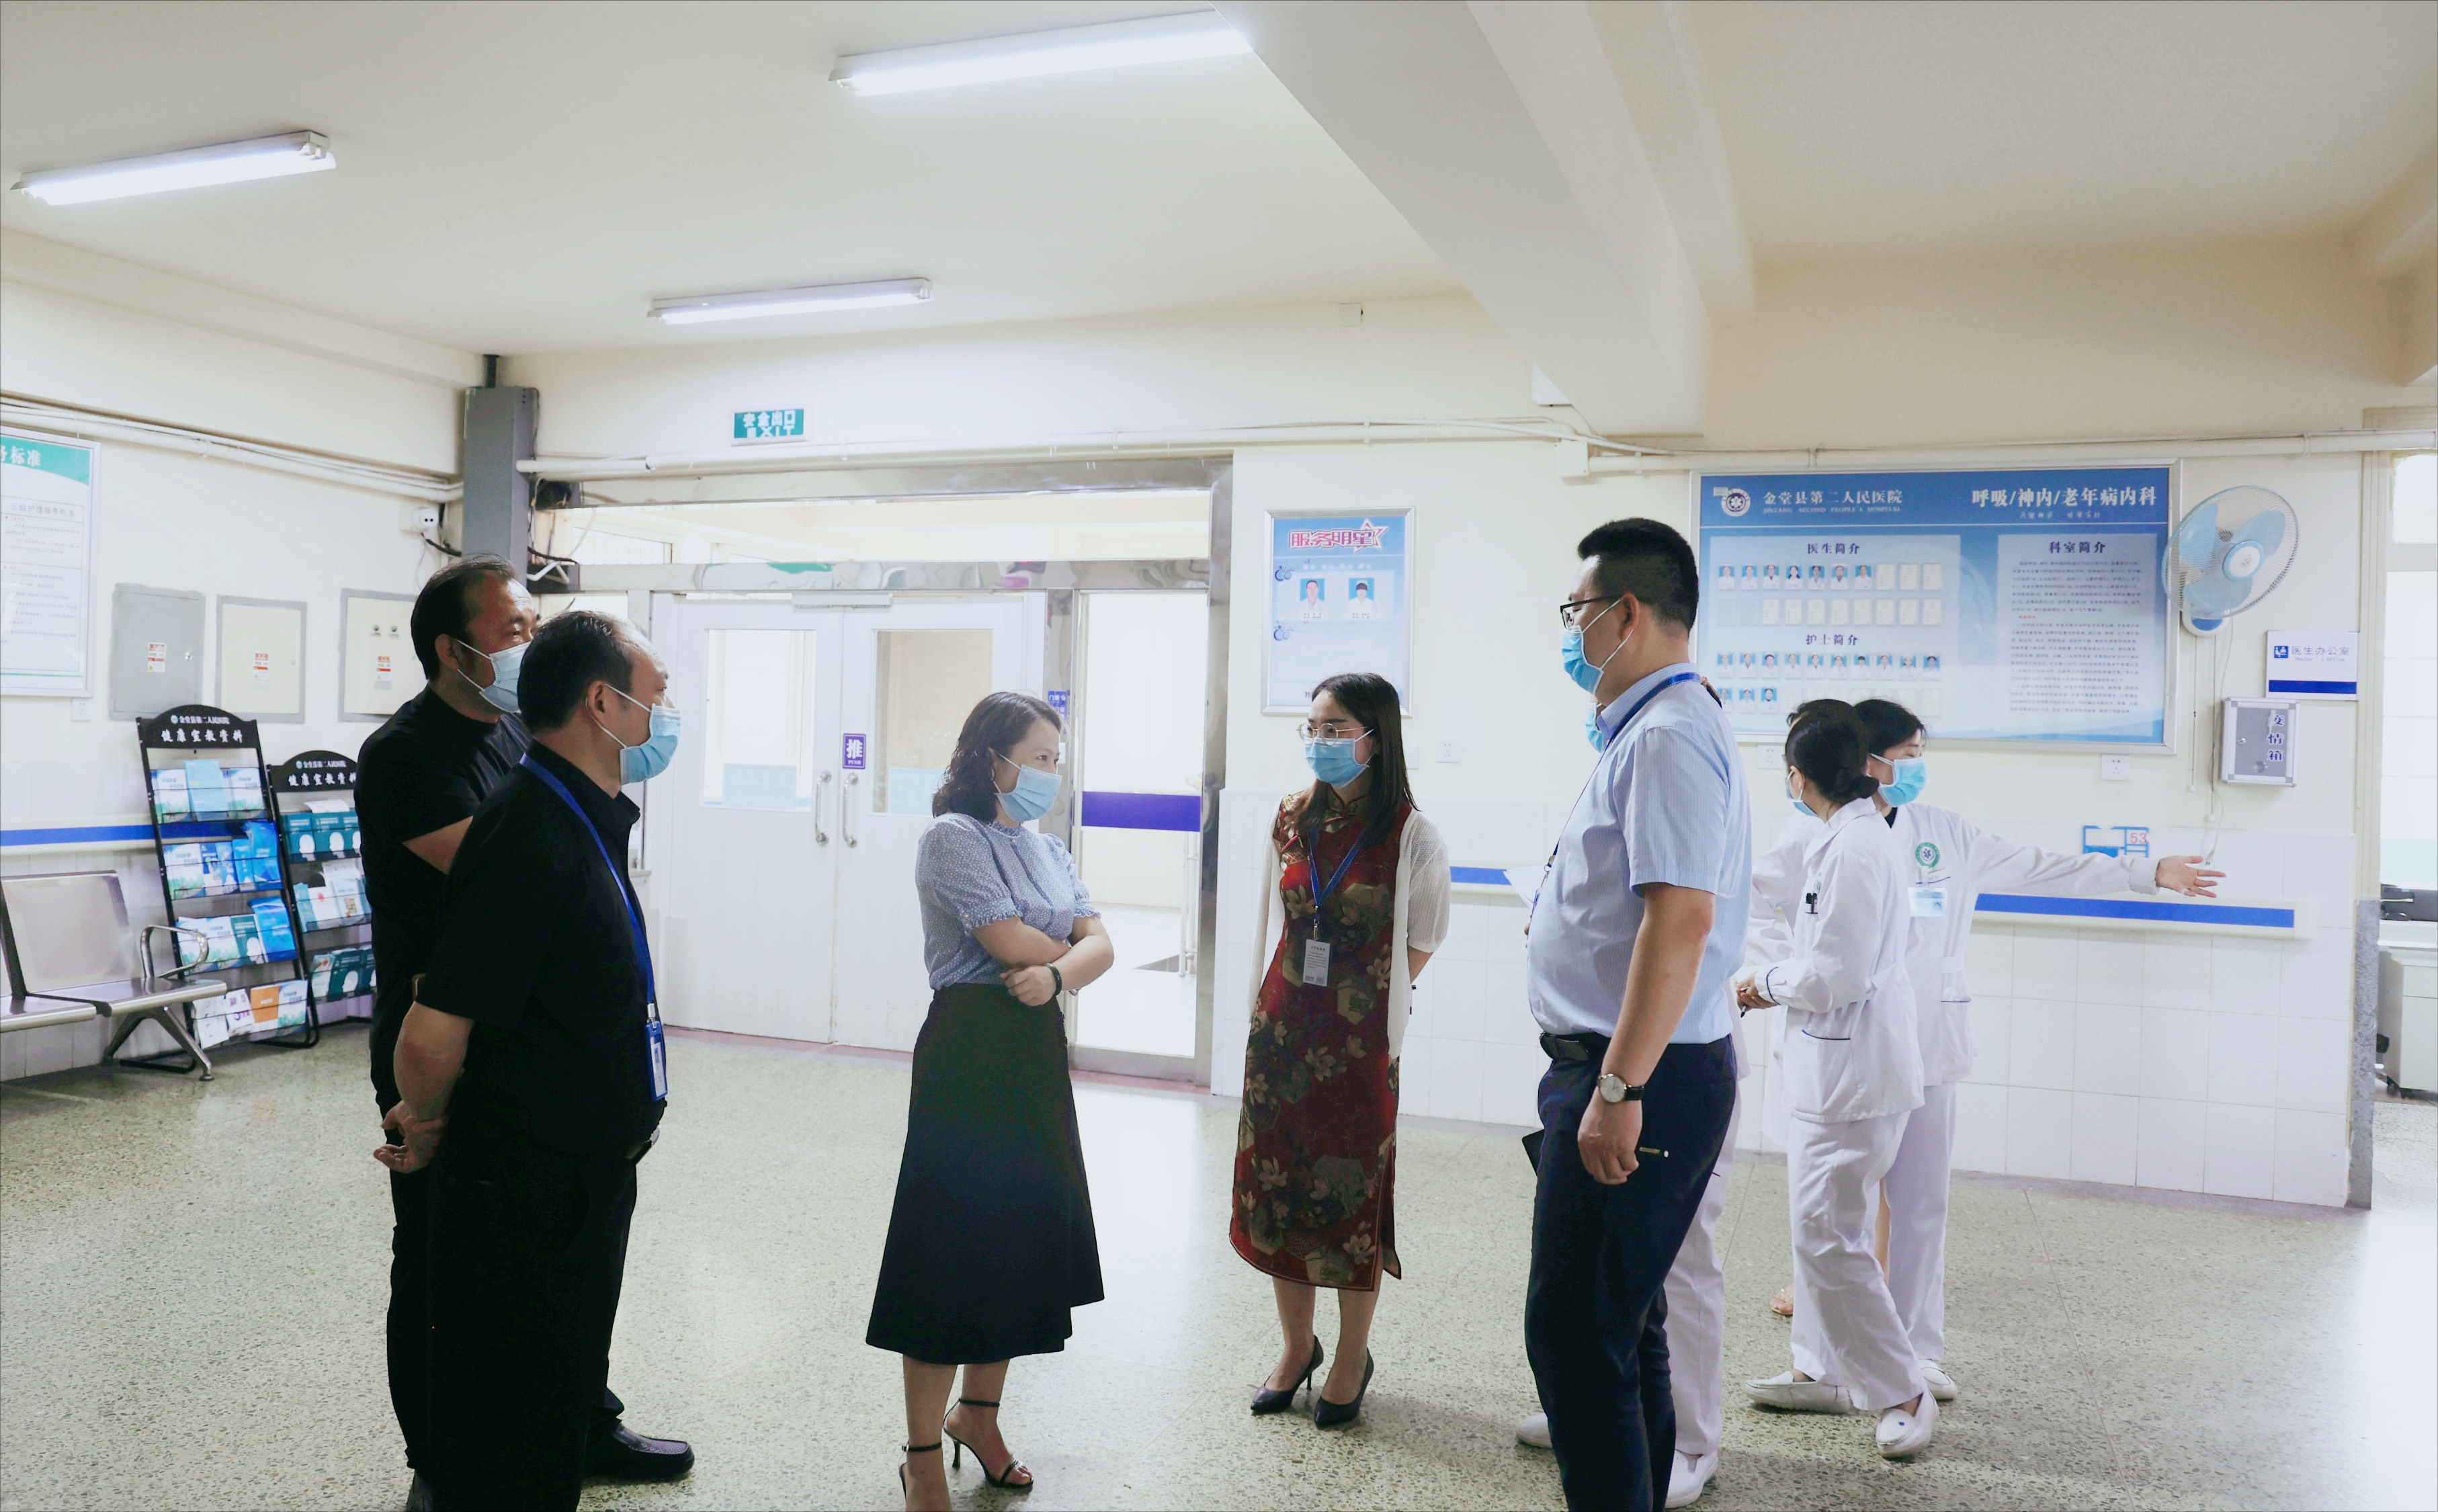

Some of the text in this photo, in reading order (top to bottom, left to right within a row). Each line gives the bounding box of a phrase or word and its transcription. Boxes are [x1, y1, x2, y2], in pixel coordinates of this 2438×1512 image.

[743, 409, 796, 428] 安全出口
[747, 425, 795, 437] EXIT
[1763, 490, 1902, 505] 金堂县第二人民医院
[1972, 487, 2156, 508] 呼吸/神内/老年病内科
[11, 503, 75, 517] 三级护理服务标准
[1288, 529, 1375, 549] 服务明星
[1808, 543, 1859, 554] 医生简介
[2050, 542, 2105, 553] 科室简介
[1806, 634, 1858, 646] 护士简介
[2292, 646, 2350, 656] 医生办公室
[846, 739, 864, 759] 推
[2130, 832, 2147, 844] 53
